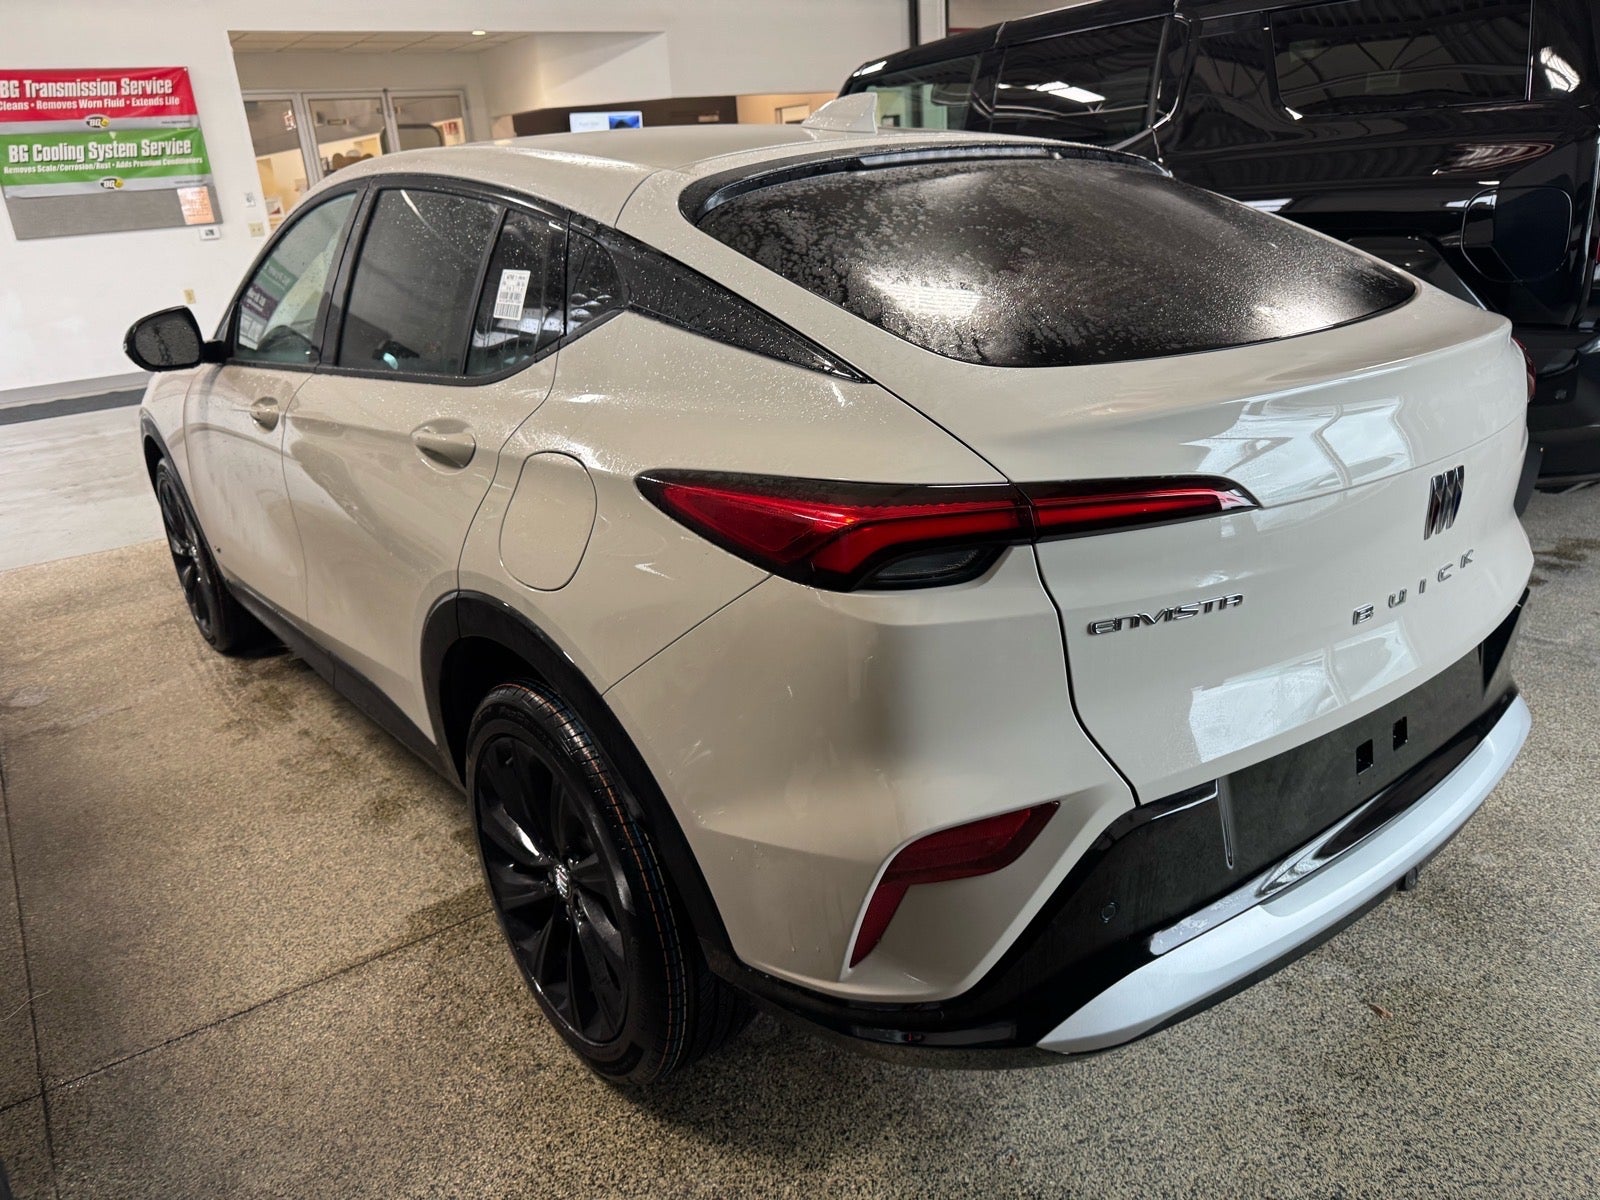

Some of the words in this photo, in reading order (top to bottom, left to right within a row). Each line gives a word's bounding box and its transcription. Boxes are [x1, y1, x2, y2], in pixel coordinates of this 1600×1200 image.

[0, 79, 20, 98] BG
[24, 78, 117, 97] Transmission
[121, 77, 172, 96] Service
[36, 100, 77, 110] Removes
[79, 99, 102, 108] Worn
[103, 98, 125, 108] Fluid
[131, 97, 164, 107] Extends
[165, 96, 180, 106] Life
[89, 117, 101, 127] BG
[8, 145, 28, 163] BG
[33, 143, 85, 163] Cooling
[88, 141, 137, 161] System
[141, 138, 192, 157] Service
[4, 165, 36, 174] Removes
[37, 162, 111, 173] Scale/Corrosion/Rust
[115, 160, 132, 169] Adds
[133, 158, 162, 168] Premium
[162, 156, 203, 166] Conditioners
[103, 180, 115, 189] BG
[1351, 549, 1476, 625] BUICK
[1088, 592, 1244, 636] ENVISTA
